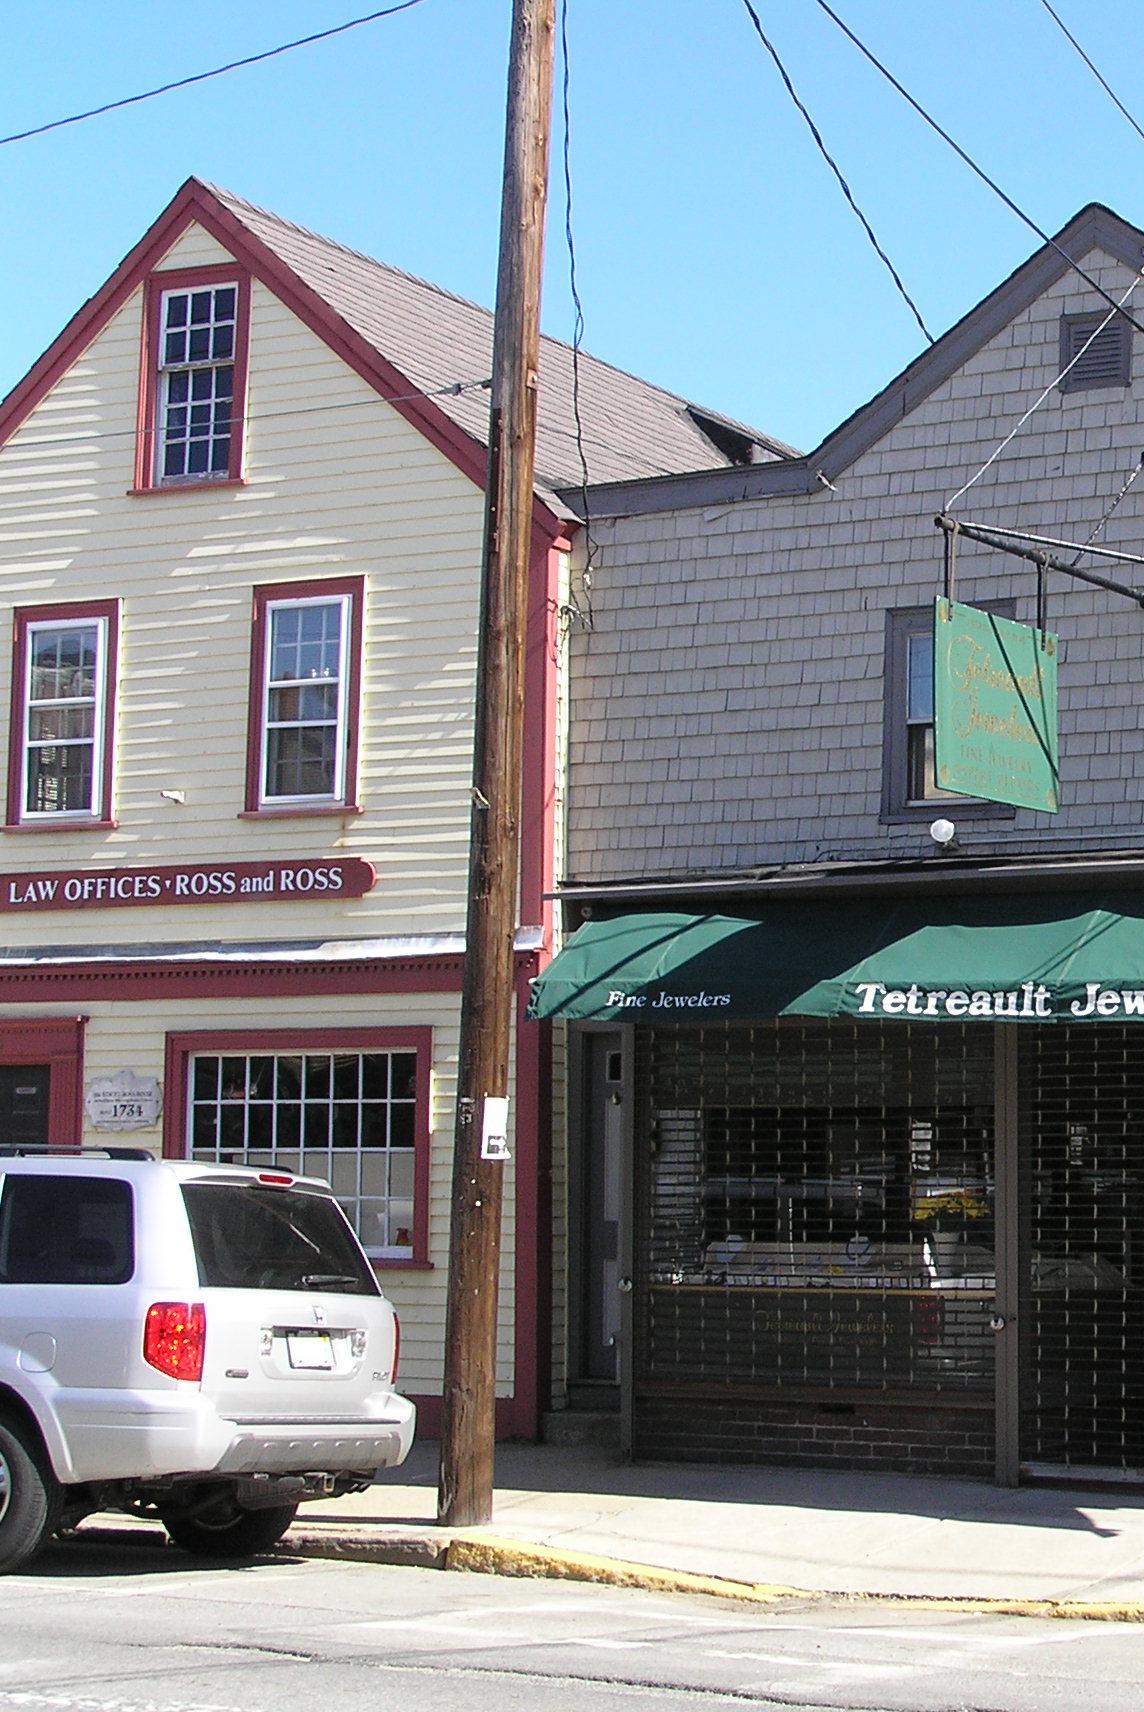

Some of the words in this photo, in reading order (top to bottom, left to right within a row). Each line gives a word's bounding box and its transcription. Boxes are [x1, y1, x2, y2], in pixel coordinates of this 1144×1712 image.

[9, 880, 59, 903] LAW
[64, 875, 162, 901] OFFICES
[175, 871, 237, 896] ROSS
[240, 870, 275, 894] and
[280, 867, 343, 891] ROSS
[605, 990, 647, 1007] Fine
[651, 991, 731, 1008] Jewelers
[855, 981, 1053, 1017] Tetreault
[112, 1104, 144, 1118] 1734
